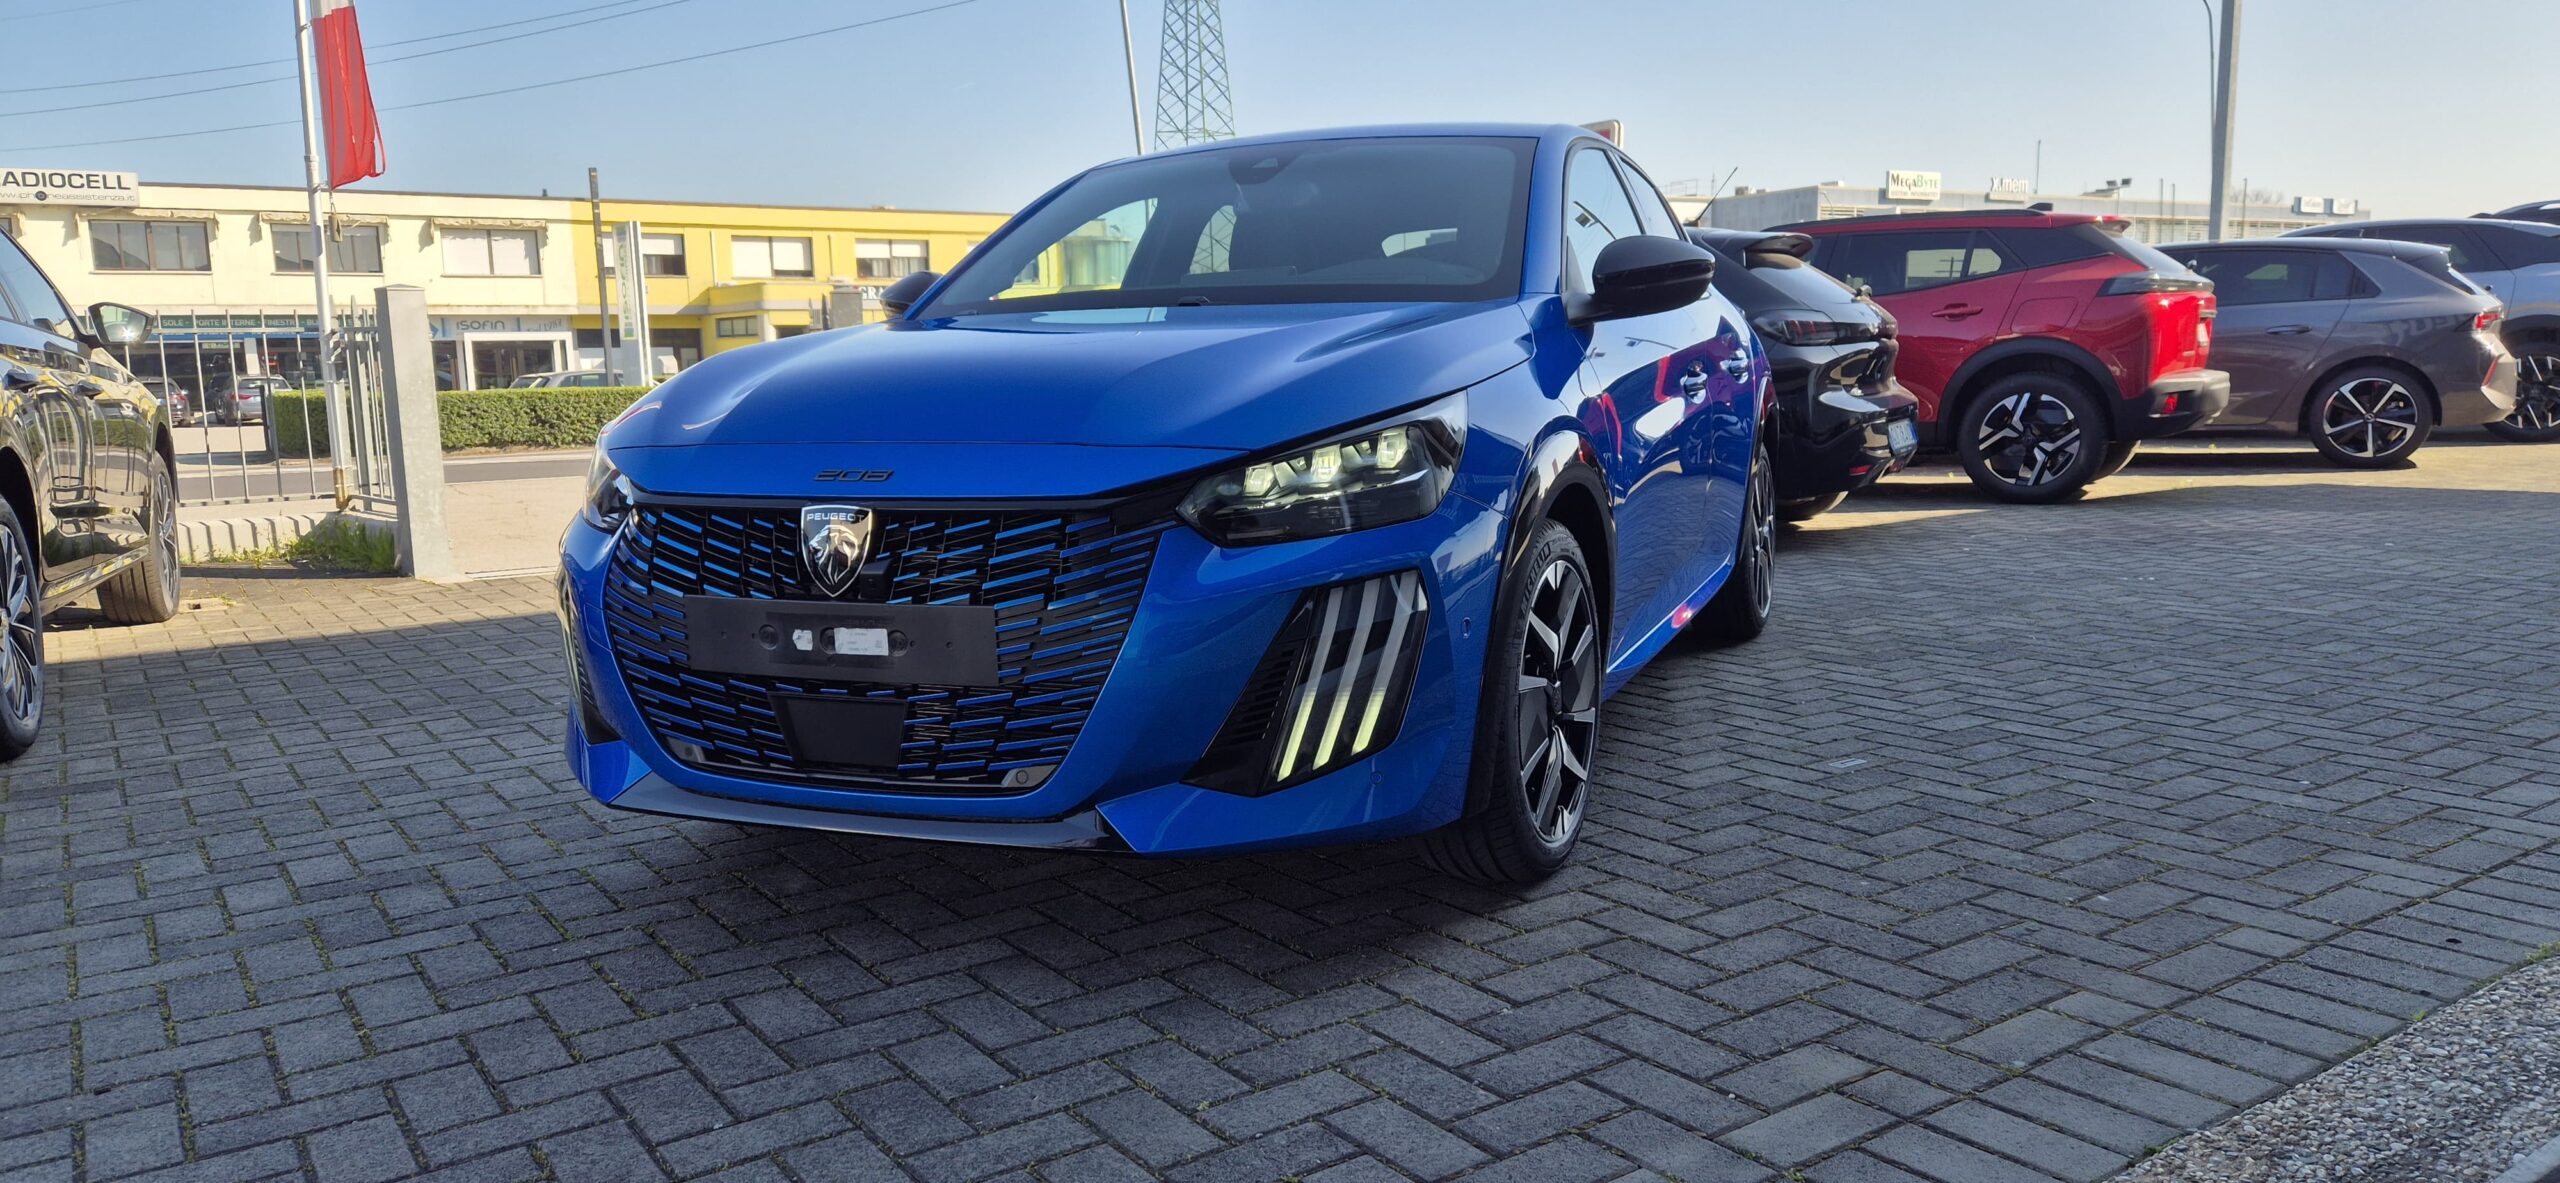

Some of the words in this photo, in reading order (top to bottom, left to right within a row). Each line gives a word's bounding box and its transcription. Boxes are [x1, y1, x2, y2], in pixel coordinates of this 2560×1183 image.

[0, 171, 131, 190] ADIOCELL
[456, 320, 506, 331] ISOFIN
[815, 469, 894, 482] 208
[807, 512, 865, 522] PEUGEOT
